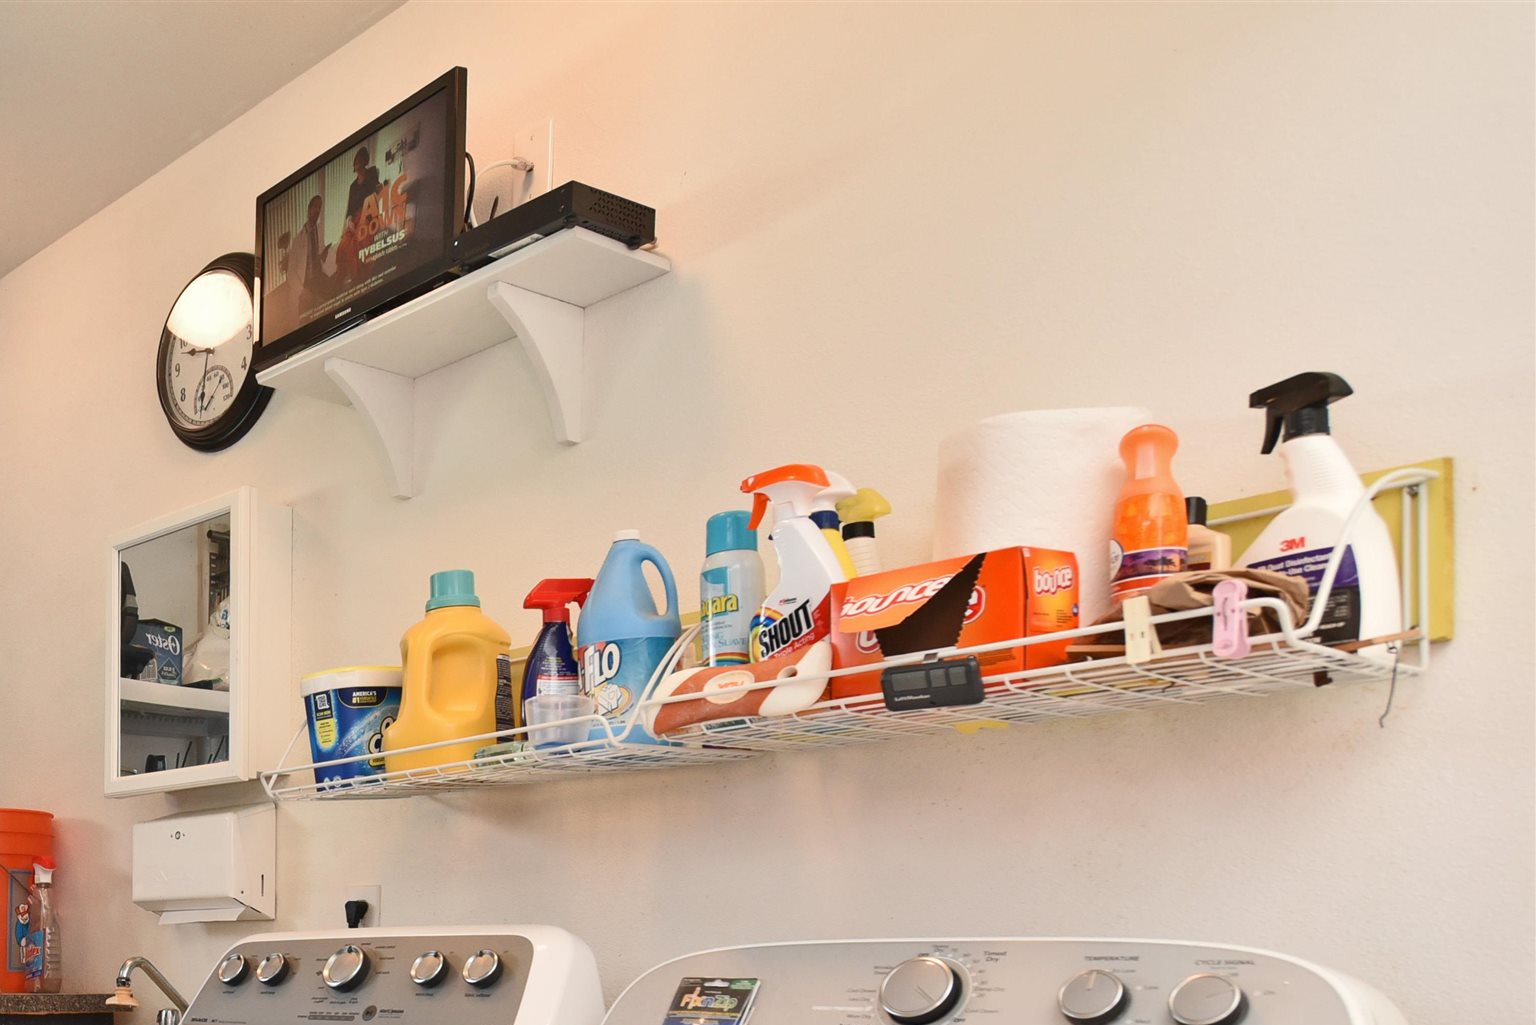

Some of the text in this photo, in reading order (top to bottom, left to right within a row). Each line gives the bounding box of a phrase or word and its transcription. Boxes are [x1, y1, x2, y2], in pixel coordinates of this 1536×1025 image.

[359, 229, 406, 263] RYBELSUS
[246, 324, 253, 340] 3
[175, 363, 181, 378] 9
[241, 356, 248, 371] 4
[180, 387, 187, 402] 8
[1279, 536, 1306, 552] 3M
[1033, 567, 1073, 594] bounce
[759, 599, 813, 658] SHOUT
